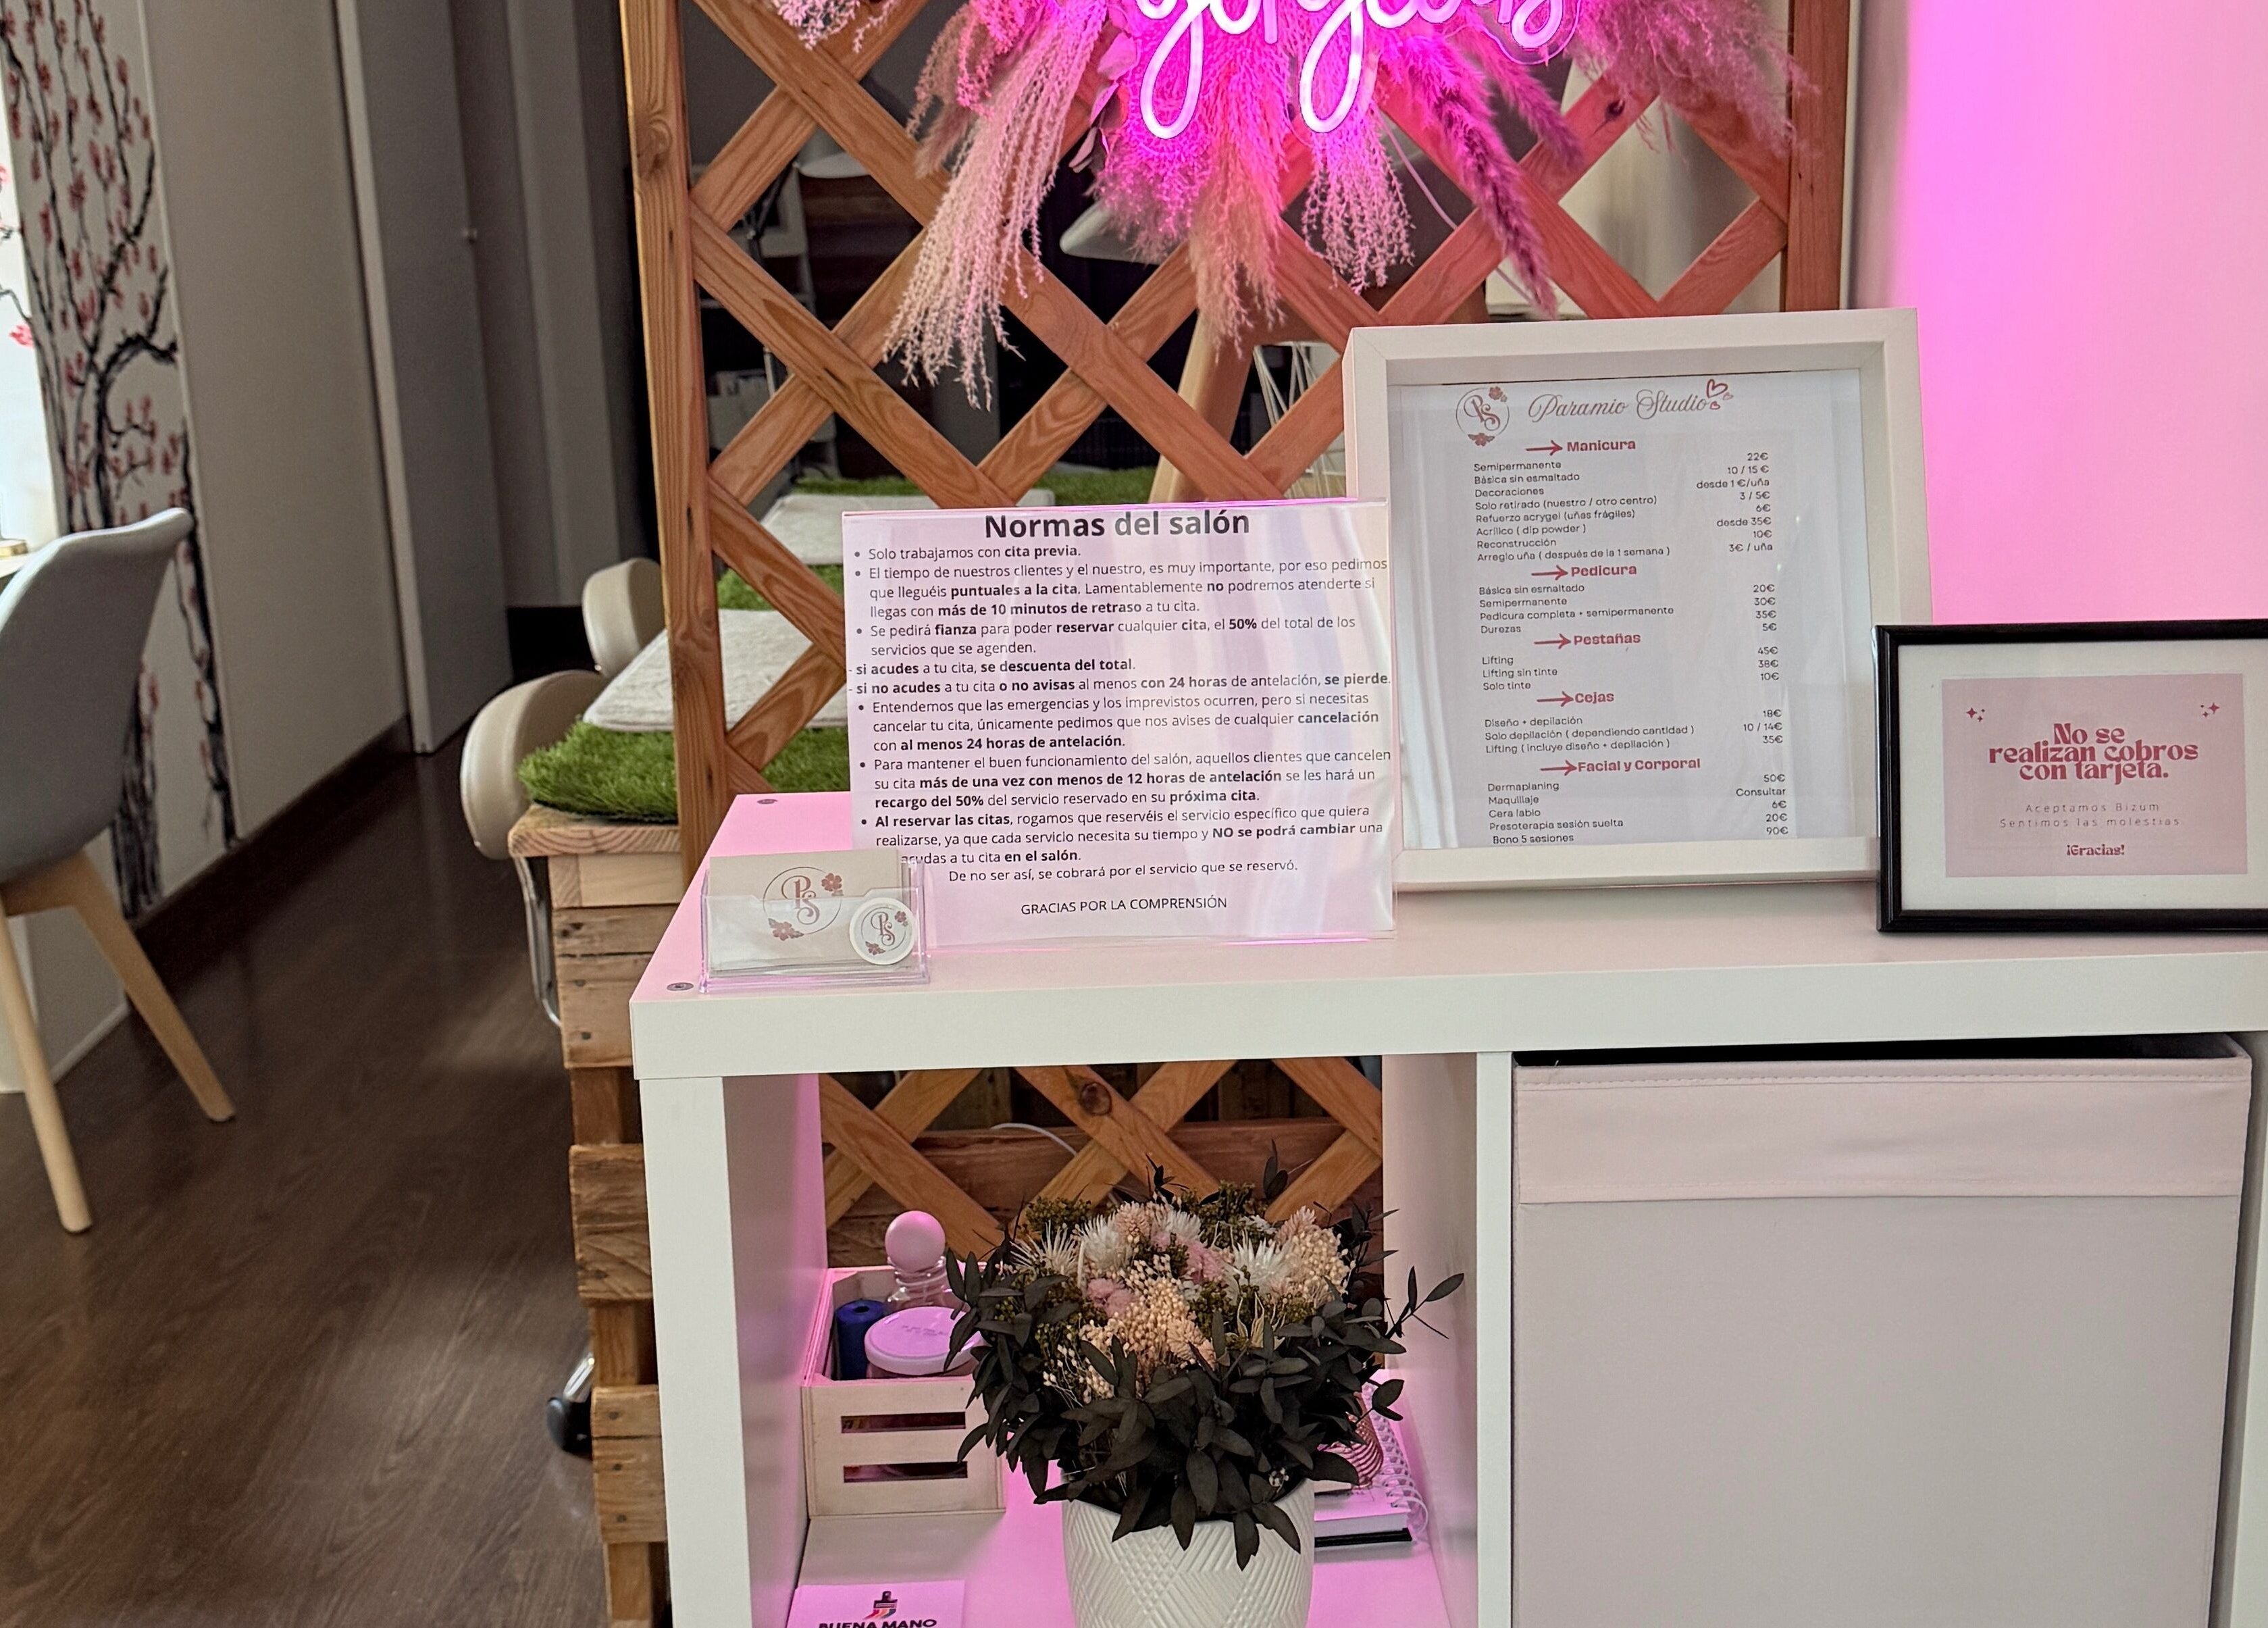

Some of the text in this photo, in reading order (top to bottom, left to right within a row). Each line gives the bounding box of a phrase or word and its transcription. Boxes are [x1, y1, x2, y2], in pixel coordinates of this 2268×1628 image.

[1528, 389, 1708, 423] Paramio Studio
[1567, 440, 1635, 452] Manicura
[1747, 452, 1768, 461] 22€
[1474, 461, 1562, 472] Semipermanente
[1474, 472, 1580, 484] Básica sin esmaltado
[1697, 480, 1728, 488] desde
[1730, 479, 1734, 487] 1
[1475, 487, 1544, 497] Decoraciones
[1756, 503, 1771, 512] 6€
[1476, 508, 1634, 522] Refuerzo acrygel (uñas frágiles)
[985, 509, 1250, 538] Normas del salón
[1717, 516, 1772, 527] desde 35€
[1753, 529, 1772, 538] 10€
[1477, 537, 1556, 549] Reconstrucción
[869, 544, 1081, 562] Solo trabajamos con cita previa.
[869, 557, 1389, 582] El tiempo de nuestros clientes y el nuestro, es muy importante, por eso pedimos
[1571, 565, 1636, 576] Pedicura
[1479, 586, 1512, 594] Básica
[1531, 583, 1584, 593] esmaltado
[1753, 584, 1775, 592] 20€
[1480, 597, 1567, 609] Semipermanente
[1755, 596, 1776, 605] 30€
[871, 599, 1200, 621] llegas con más de 10 minutos de retraso a tu cita.
[1756, 609, 1776, 619] 35€
[1481, 625, 1521, 634] Durezas
[1763, 622, 1777, 631] 5€
[1574, 633, 1641, 644] Pestañas
[871, 640, 1036, 659] servicios que se agenden.
[1758, 646, 1778, 655] 45€
[1483, 655, 1513, 666] Lifting
[1759, 659, 1778, 668] 38€
[1483, 668, 1514, 679] Lifting
[1517, 668, 1531, 676] sin
[1761, 671, 1779, 680] 10€
[1483, 681, 1530, 690] Solo tinte
[1575, 692, 1614, 704] Cejas
[1763, 709, 1781, 717] 18€
[873, 709, 1379, 732] cancelar tu cita, únicamente pedimos que nos avises de cualquier cancelación
[2053, 722, 2126, 745] No se
[873, 734, 1125, 752] con al menos 24 horas de antelación.
[1763, 735, 1782, 744] 35€
[1988, 739, 2200, 763] realizan cobros
[1578, 758, 1700, 771] Facial y Corporal
[1763, 773, 1785, 782] 50€
[2018, 759, 2169, 785] con tarjeta.
[1488, 782, 1559, 793] Dermaplaning
[1736, 787, 1786, 796] Consultar
[875, 789, 1260, 811] recargo del 50% del servicio reservado en su próxima cita.
[1489, 794, 1539, 806] Maquillaje
[1772, 800, 1786, 808] 6€
[1489, 808, 1541, 818] Cera labio
[2026, 802, 2160, 813] Aceptamos Bizum
[1766, 813, 1787, 821] 20€
[1999, 815, 2181, 828] Sentimos las molestias
[1490, 819, 1623, 832] Presoterapia sesión suelta
[1767, 825, 1788, 834] 90€
[1493, 834, 1574, 844] Bono 5 sesiones
[2066, 843, 2125, 857] ¡Gracias!
[1021, 894, 1227, 915] GRACIAS POR LA COMPRENSIÓN
[881, 1619, 937, 1628] MANO
